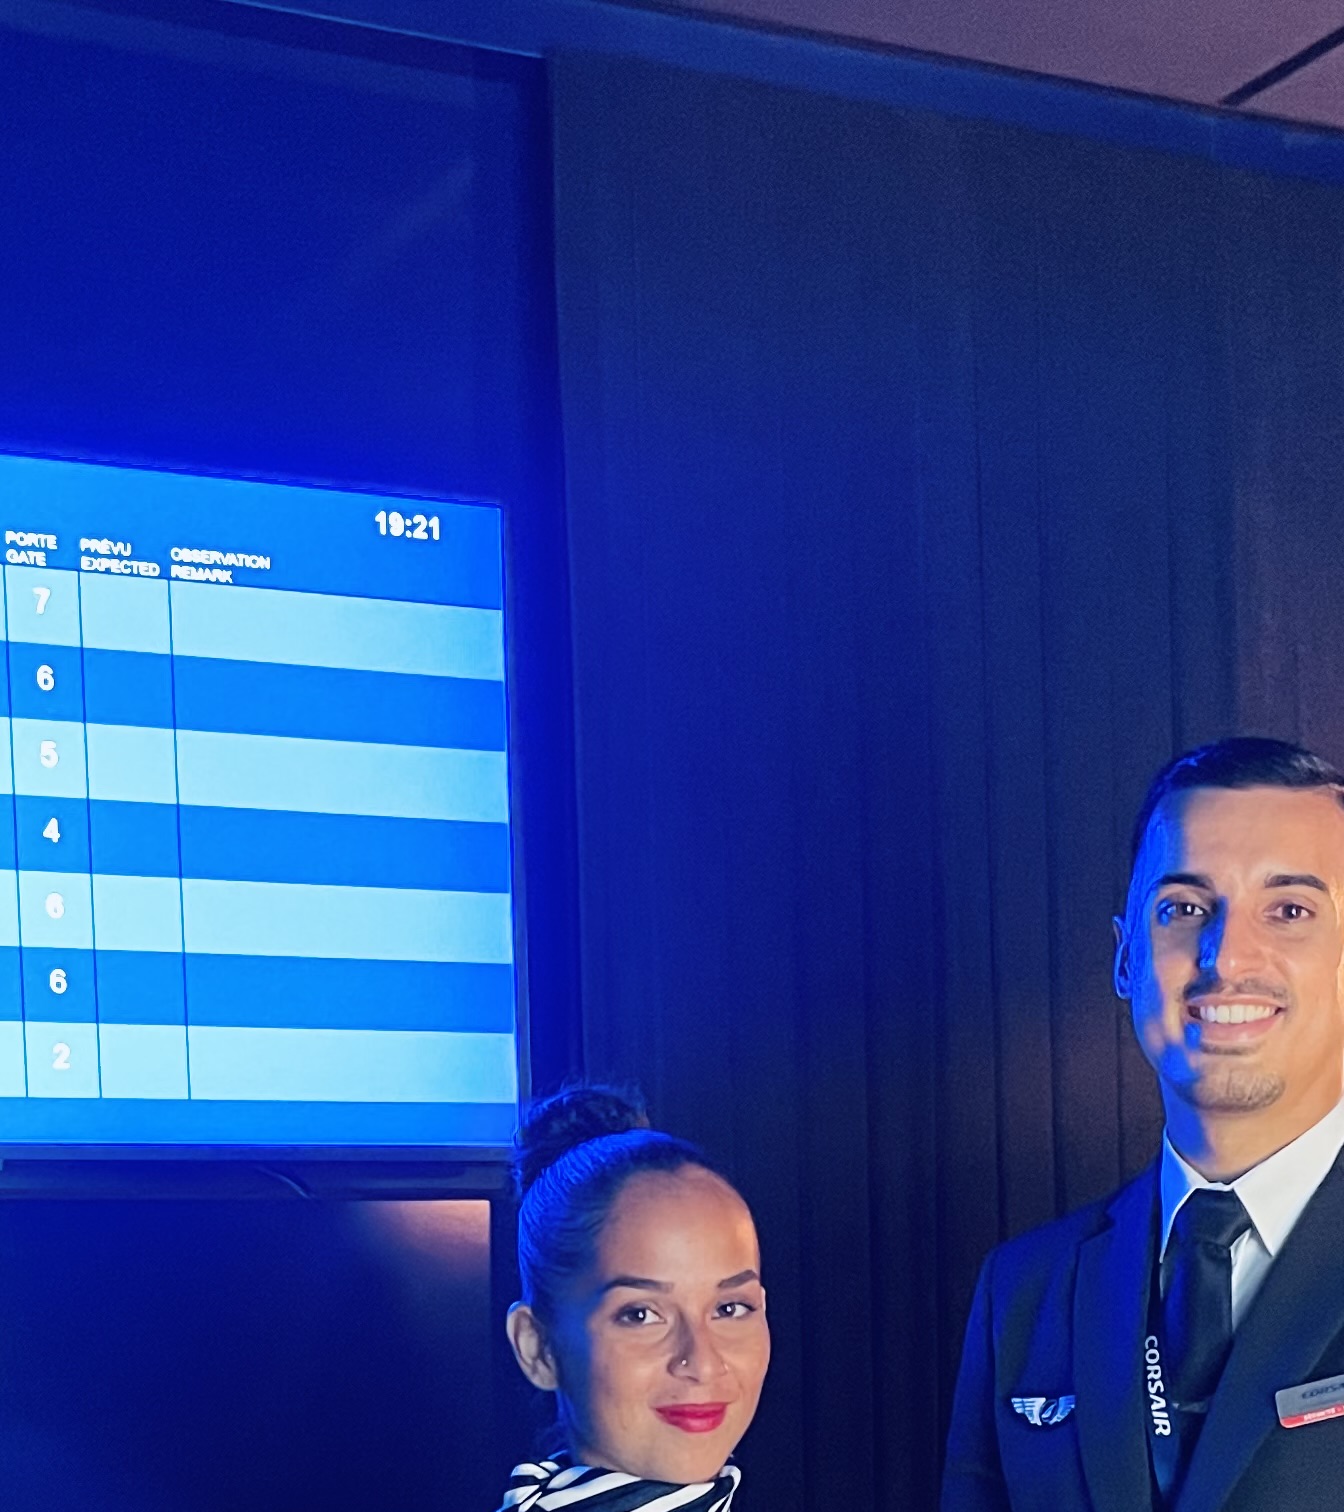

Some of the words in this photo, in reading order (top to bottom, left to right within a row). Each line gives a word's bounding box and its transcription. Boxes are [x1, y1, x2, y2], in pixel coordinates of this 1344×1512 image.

[375, 511, 439, 540] 19:21
[5, 531, 57, 549] PORTE
[171, 548, 270, 571] OBSERVATION
[6, 550, 47, 567] GATE
[80, 556, 161, 577] EXPECTED
[33, 587, 50, 614] 7
[37, 665, 54, 690] 6
[40, 741, 58, 769] 5
[43, 818, 60, 842] 4
[50, 969, 67, 994] 6
[52, 1043, 71, 1070] 2
[1144, 1335, 1172, 1436] CORSAIR
